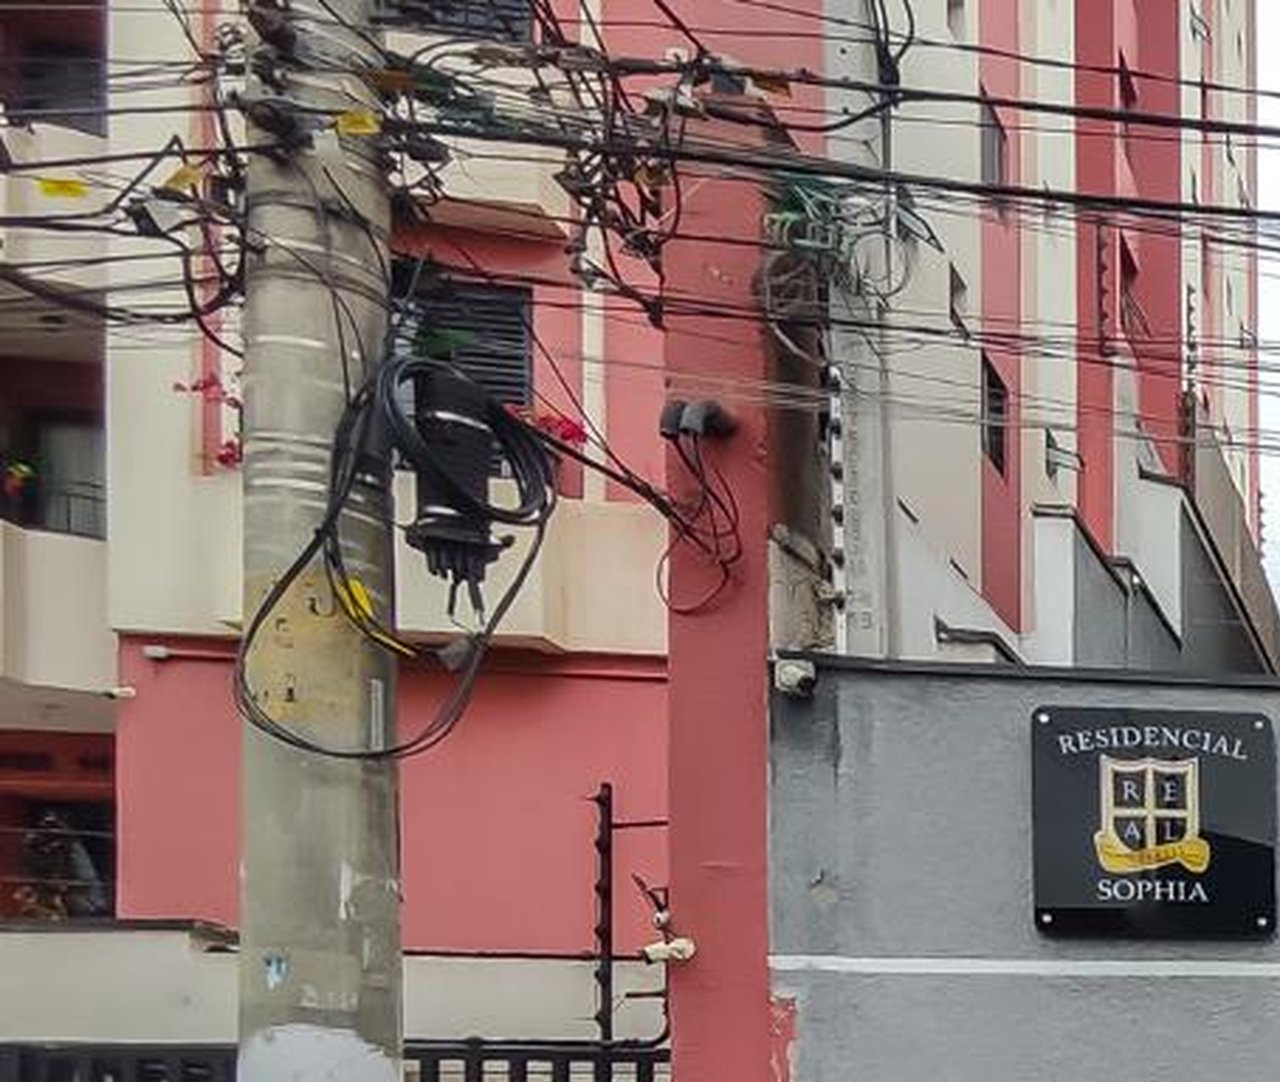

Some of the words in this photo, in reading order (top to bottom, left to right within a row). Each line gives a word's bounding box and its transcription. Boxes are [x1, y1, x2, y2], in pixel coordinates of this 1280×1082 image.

[1058, 725, 1248, 760] RESIDENCIAL
[1122, 780, 1141, 801] R
[1163, 778, 1180, 802] E
[1123, 820, 1141, 842] A
[1163, 821, 1180, 842] L
[1096, 878, 1210, 903] SOPHIA
